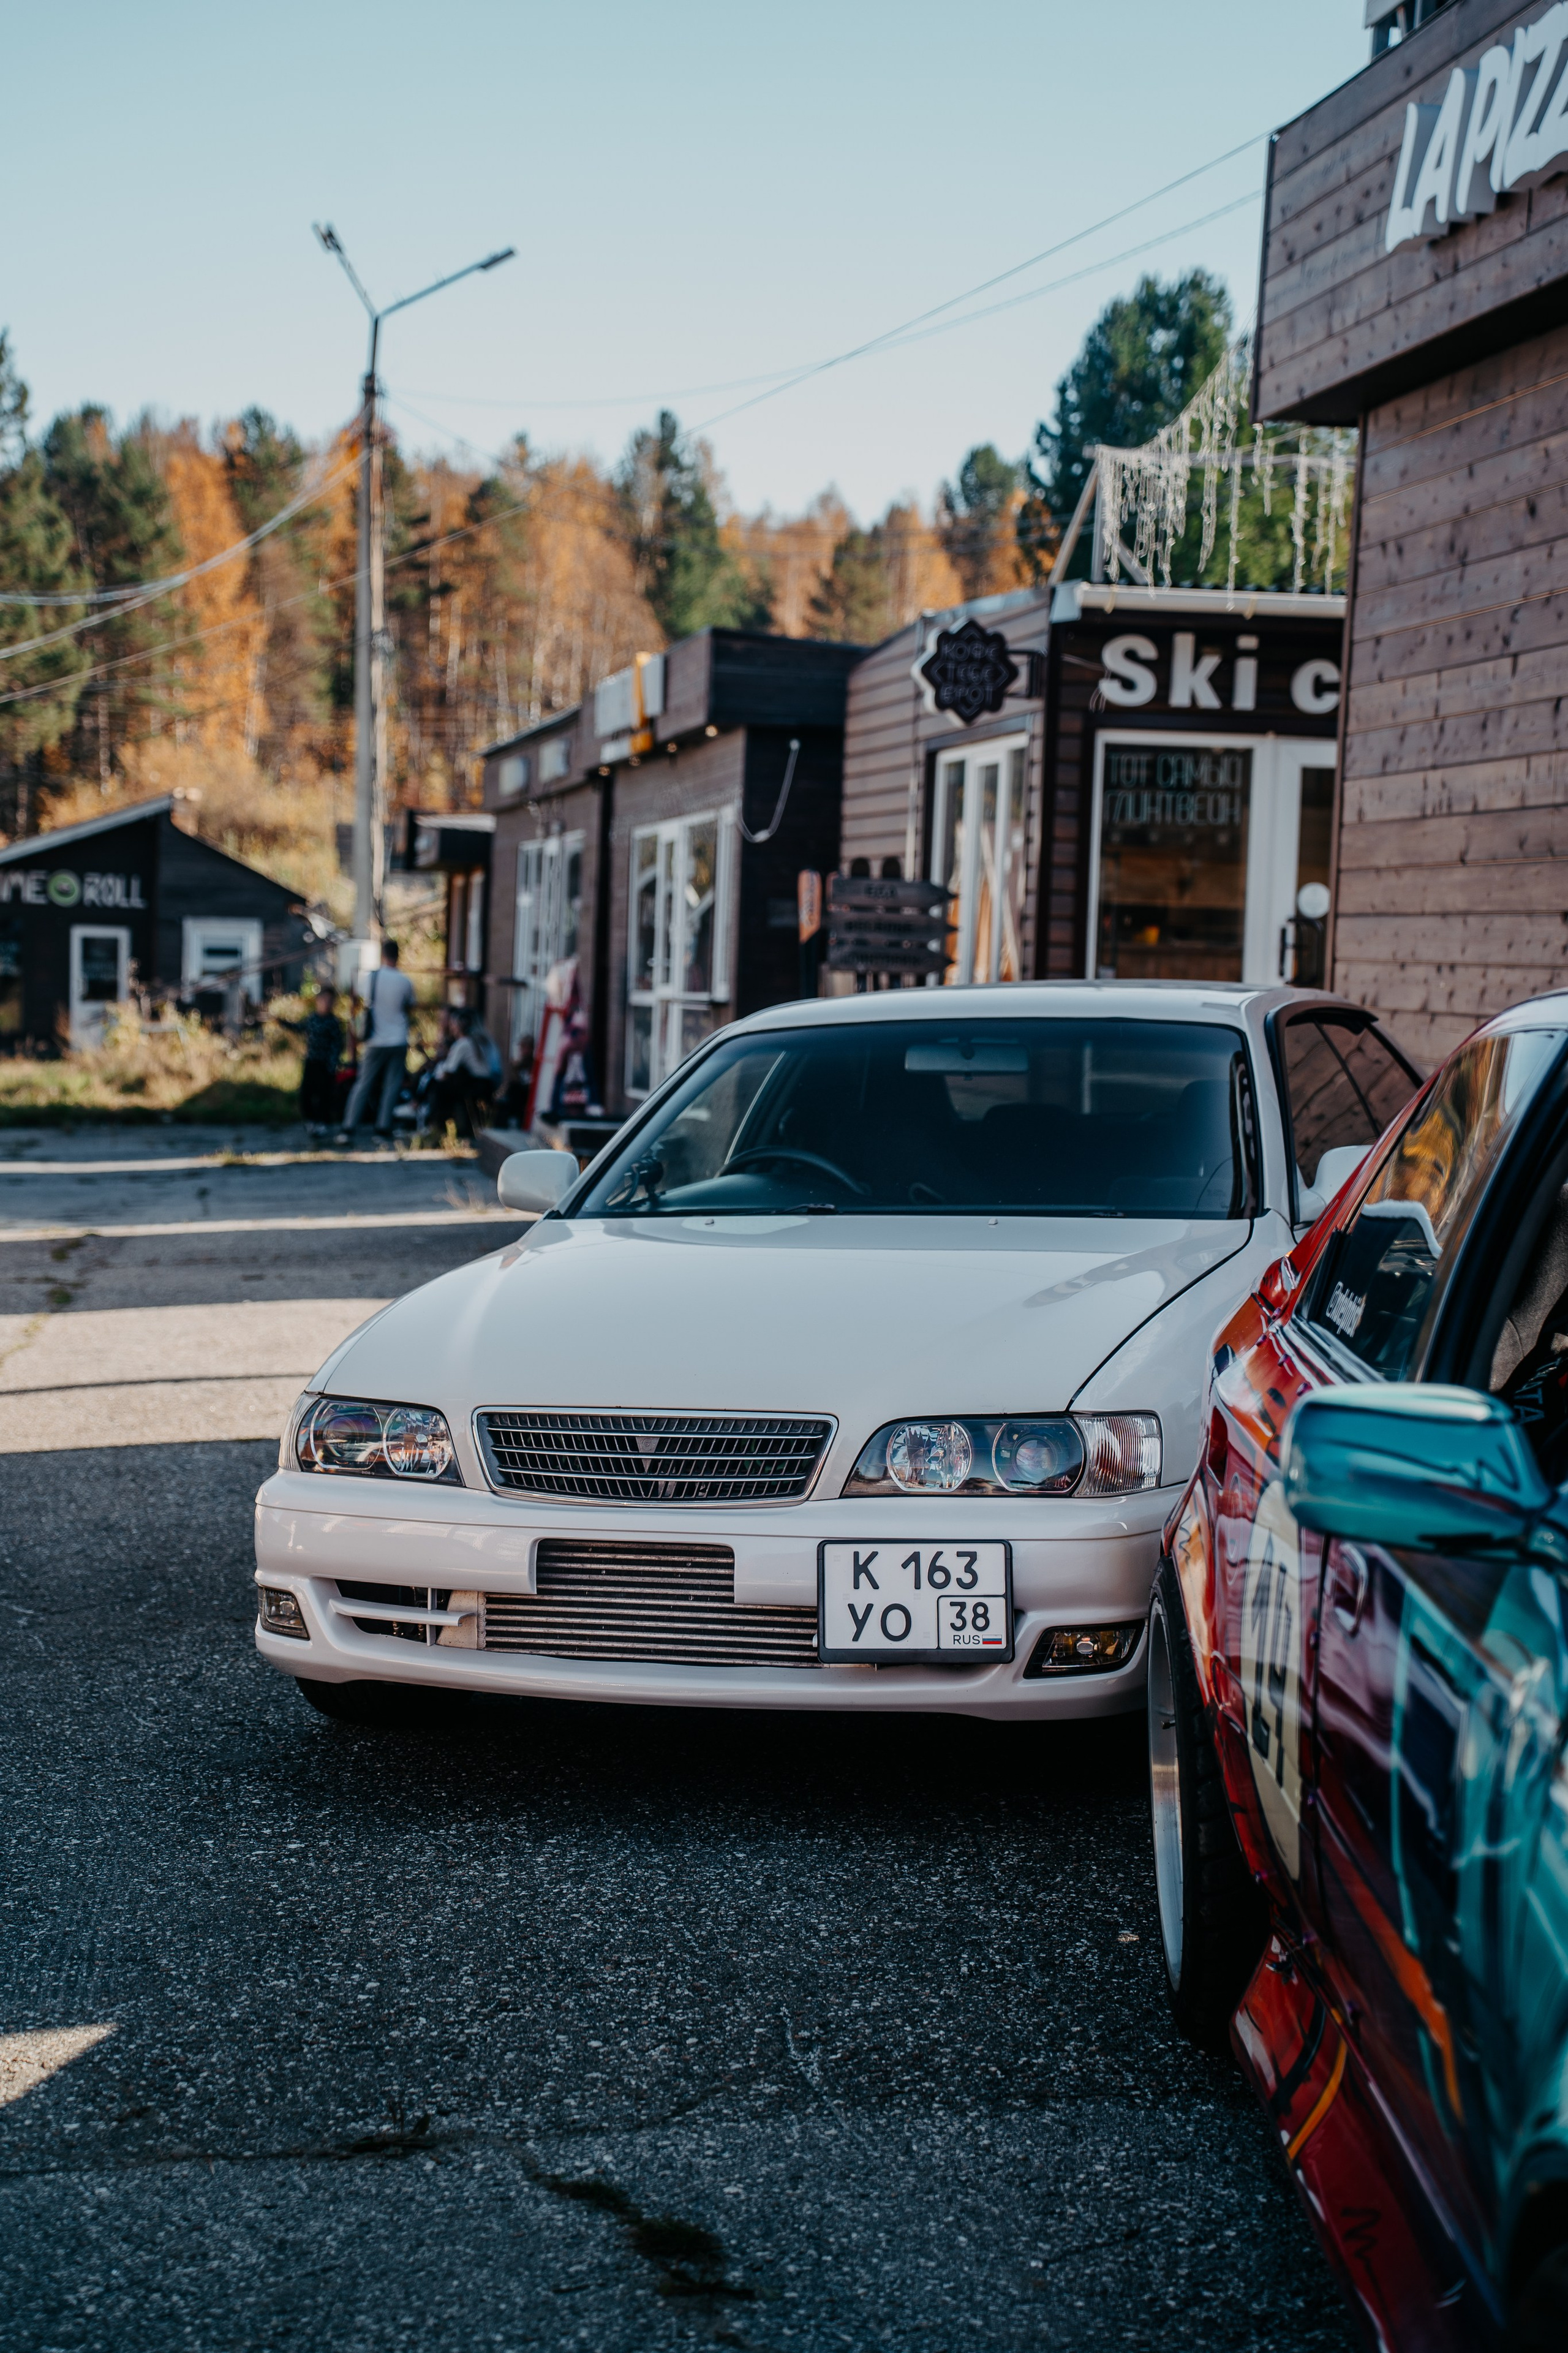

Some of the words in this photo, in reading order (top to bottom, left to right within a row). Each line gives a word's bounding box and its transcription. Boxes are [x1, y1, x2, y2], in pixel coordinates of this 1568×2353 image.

[1099, 632, 1261, 711] Ski
[83, 872, 148, 909] ROLL
[853, 1551, 880, 1590] К
[901, 1551, 978, 1590] 163
[848, 1603, 911, 1641] УО
[949, 1601, 990, 1631] 38
[953, 1634, 980, 1645] RUS
